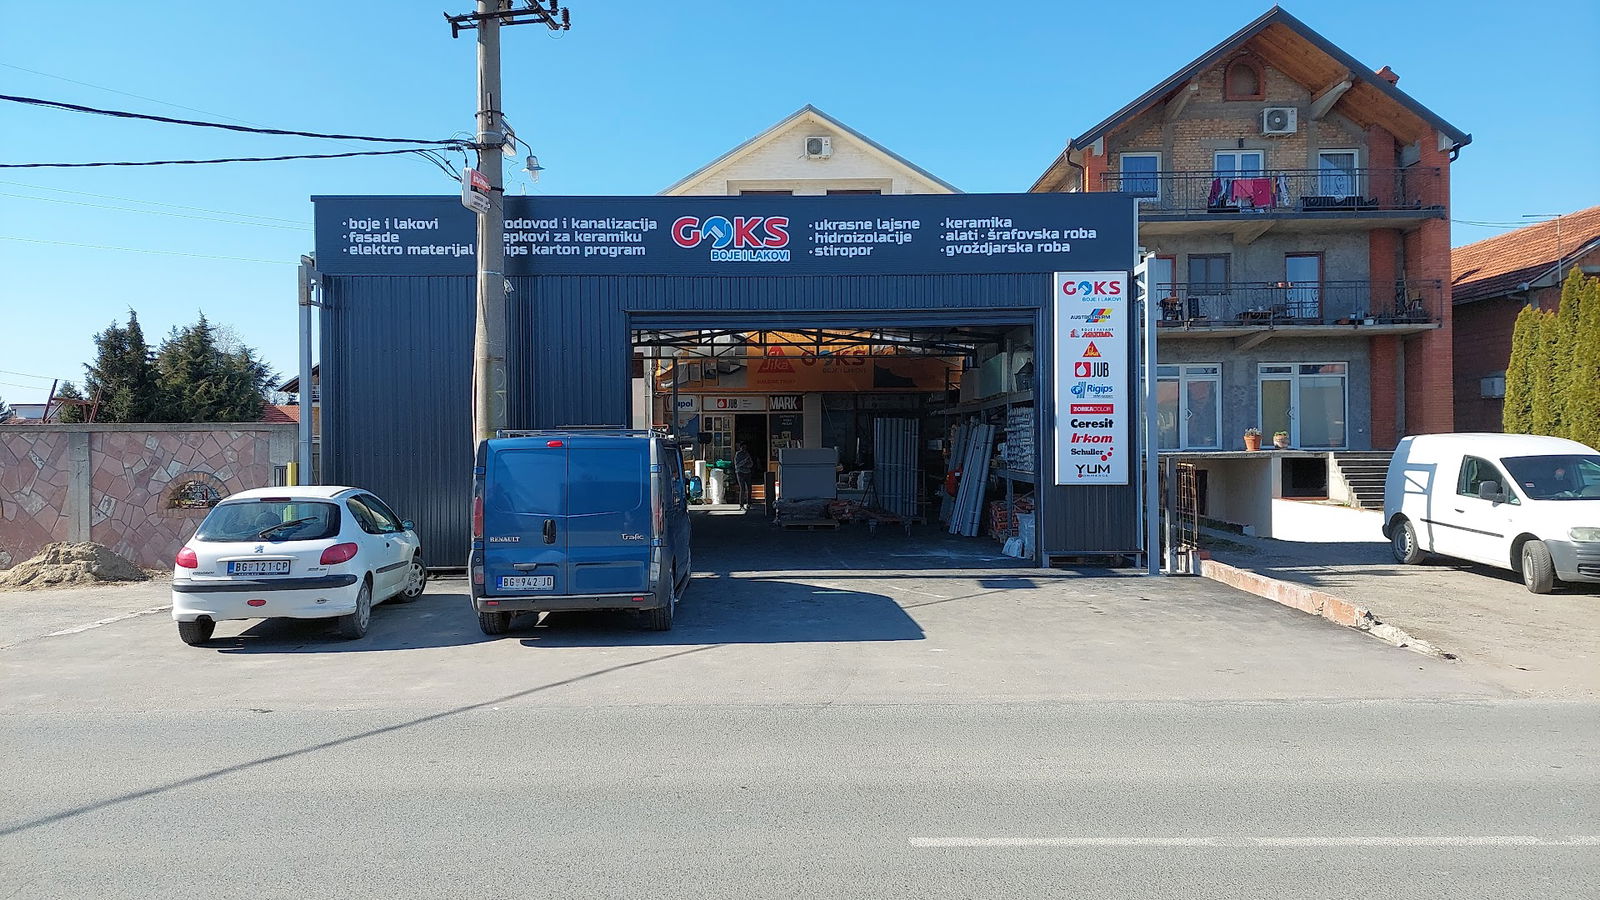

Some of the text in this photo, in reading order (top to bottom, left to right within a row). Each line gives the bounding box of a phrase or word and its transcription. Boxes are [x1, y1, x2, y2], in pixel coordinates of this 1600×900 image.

[348, 217, 439, 231] boje i lakovi
[503, 217, 657, 233] odovod i kanalizacija
[814, 217, 921, 233] ukrasne lajsne
[945, 216, 1013, 229] keramika
[348, 231, 400, 243] fasade
[503, 230, 643, 244] epkovi za keramiku
[671, 215, 790, 250] GOKS
[814, 231, 912, 246] hidroizolacije
[945, 227, 1097, 241] alati šrafovska roba
[348, 243, 475, 257] elektro materijal
[532, 243, 580, 255] karton
[584, 246, 646, 258] program
[711, 249, 790, 261] BOJE I LAKOVI
[814, 244, 873, 258] stiropor
[945, 240, 1071, 257] gvoždjarska roba
[1062, 281, 1121, 296] GOKS
[1092, 362, 1109, 378] JUB
[1087, 384, 1113, 394] Rigips
[769, 396, 798, 410] MARK
[1070, 418, 1114, 428] Ceresit
[1071, 433, 1113, 443] Irkom
[1070, 448, 1104, 456] Schuller
[1075, 464, 1111, 474] YUM
[621, 533, 645, 541] Trafic
[235, 562, 248, 572] BG
[503, 577, 515, 587] BG
